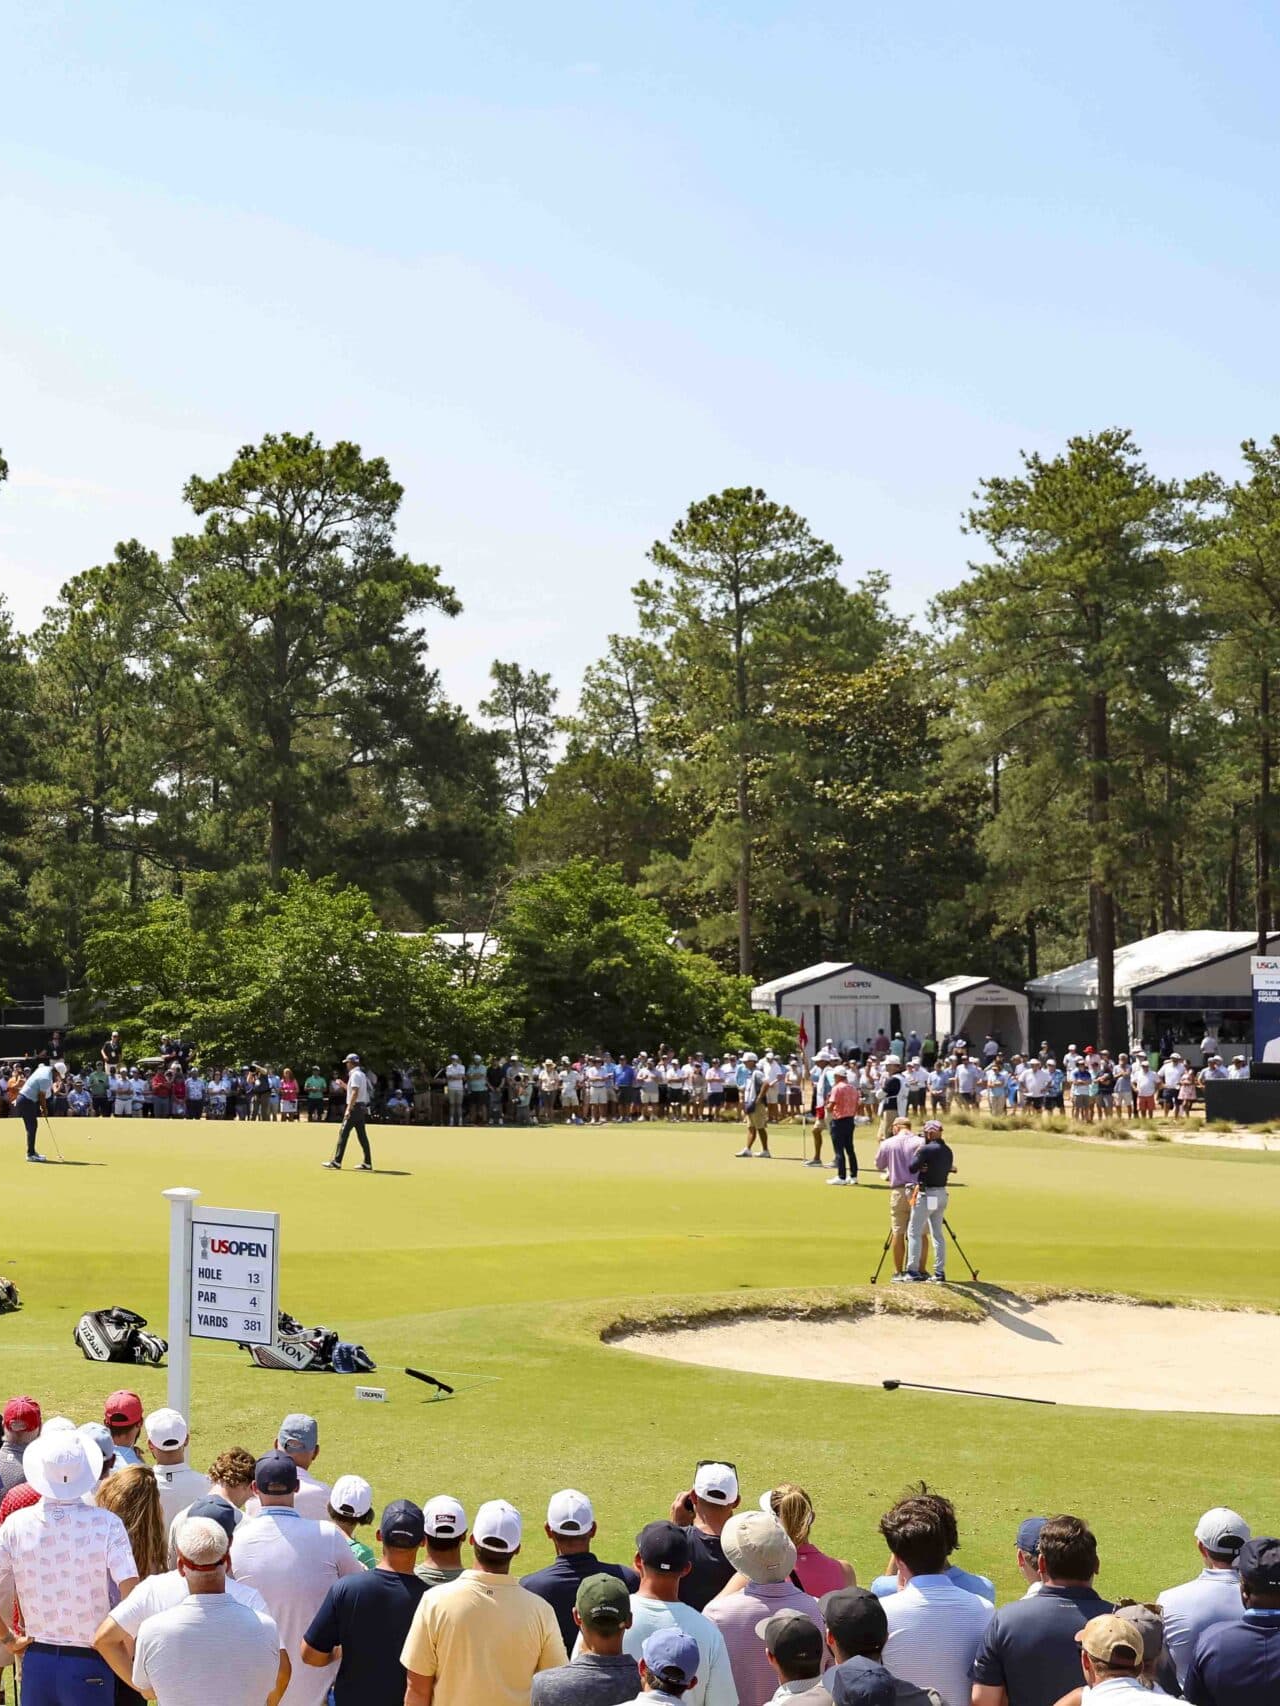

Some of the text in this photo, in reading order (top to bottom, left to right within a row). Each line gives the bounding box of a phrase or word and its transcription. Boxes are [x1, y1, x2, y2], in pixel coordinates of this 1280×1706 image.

[198, 1267, 260, 1284] HOLE 13
[198, 1290, 257, 1307] PAR 4
[197, 1313, 261, 1332] YARDS 381
